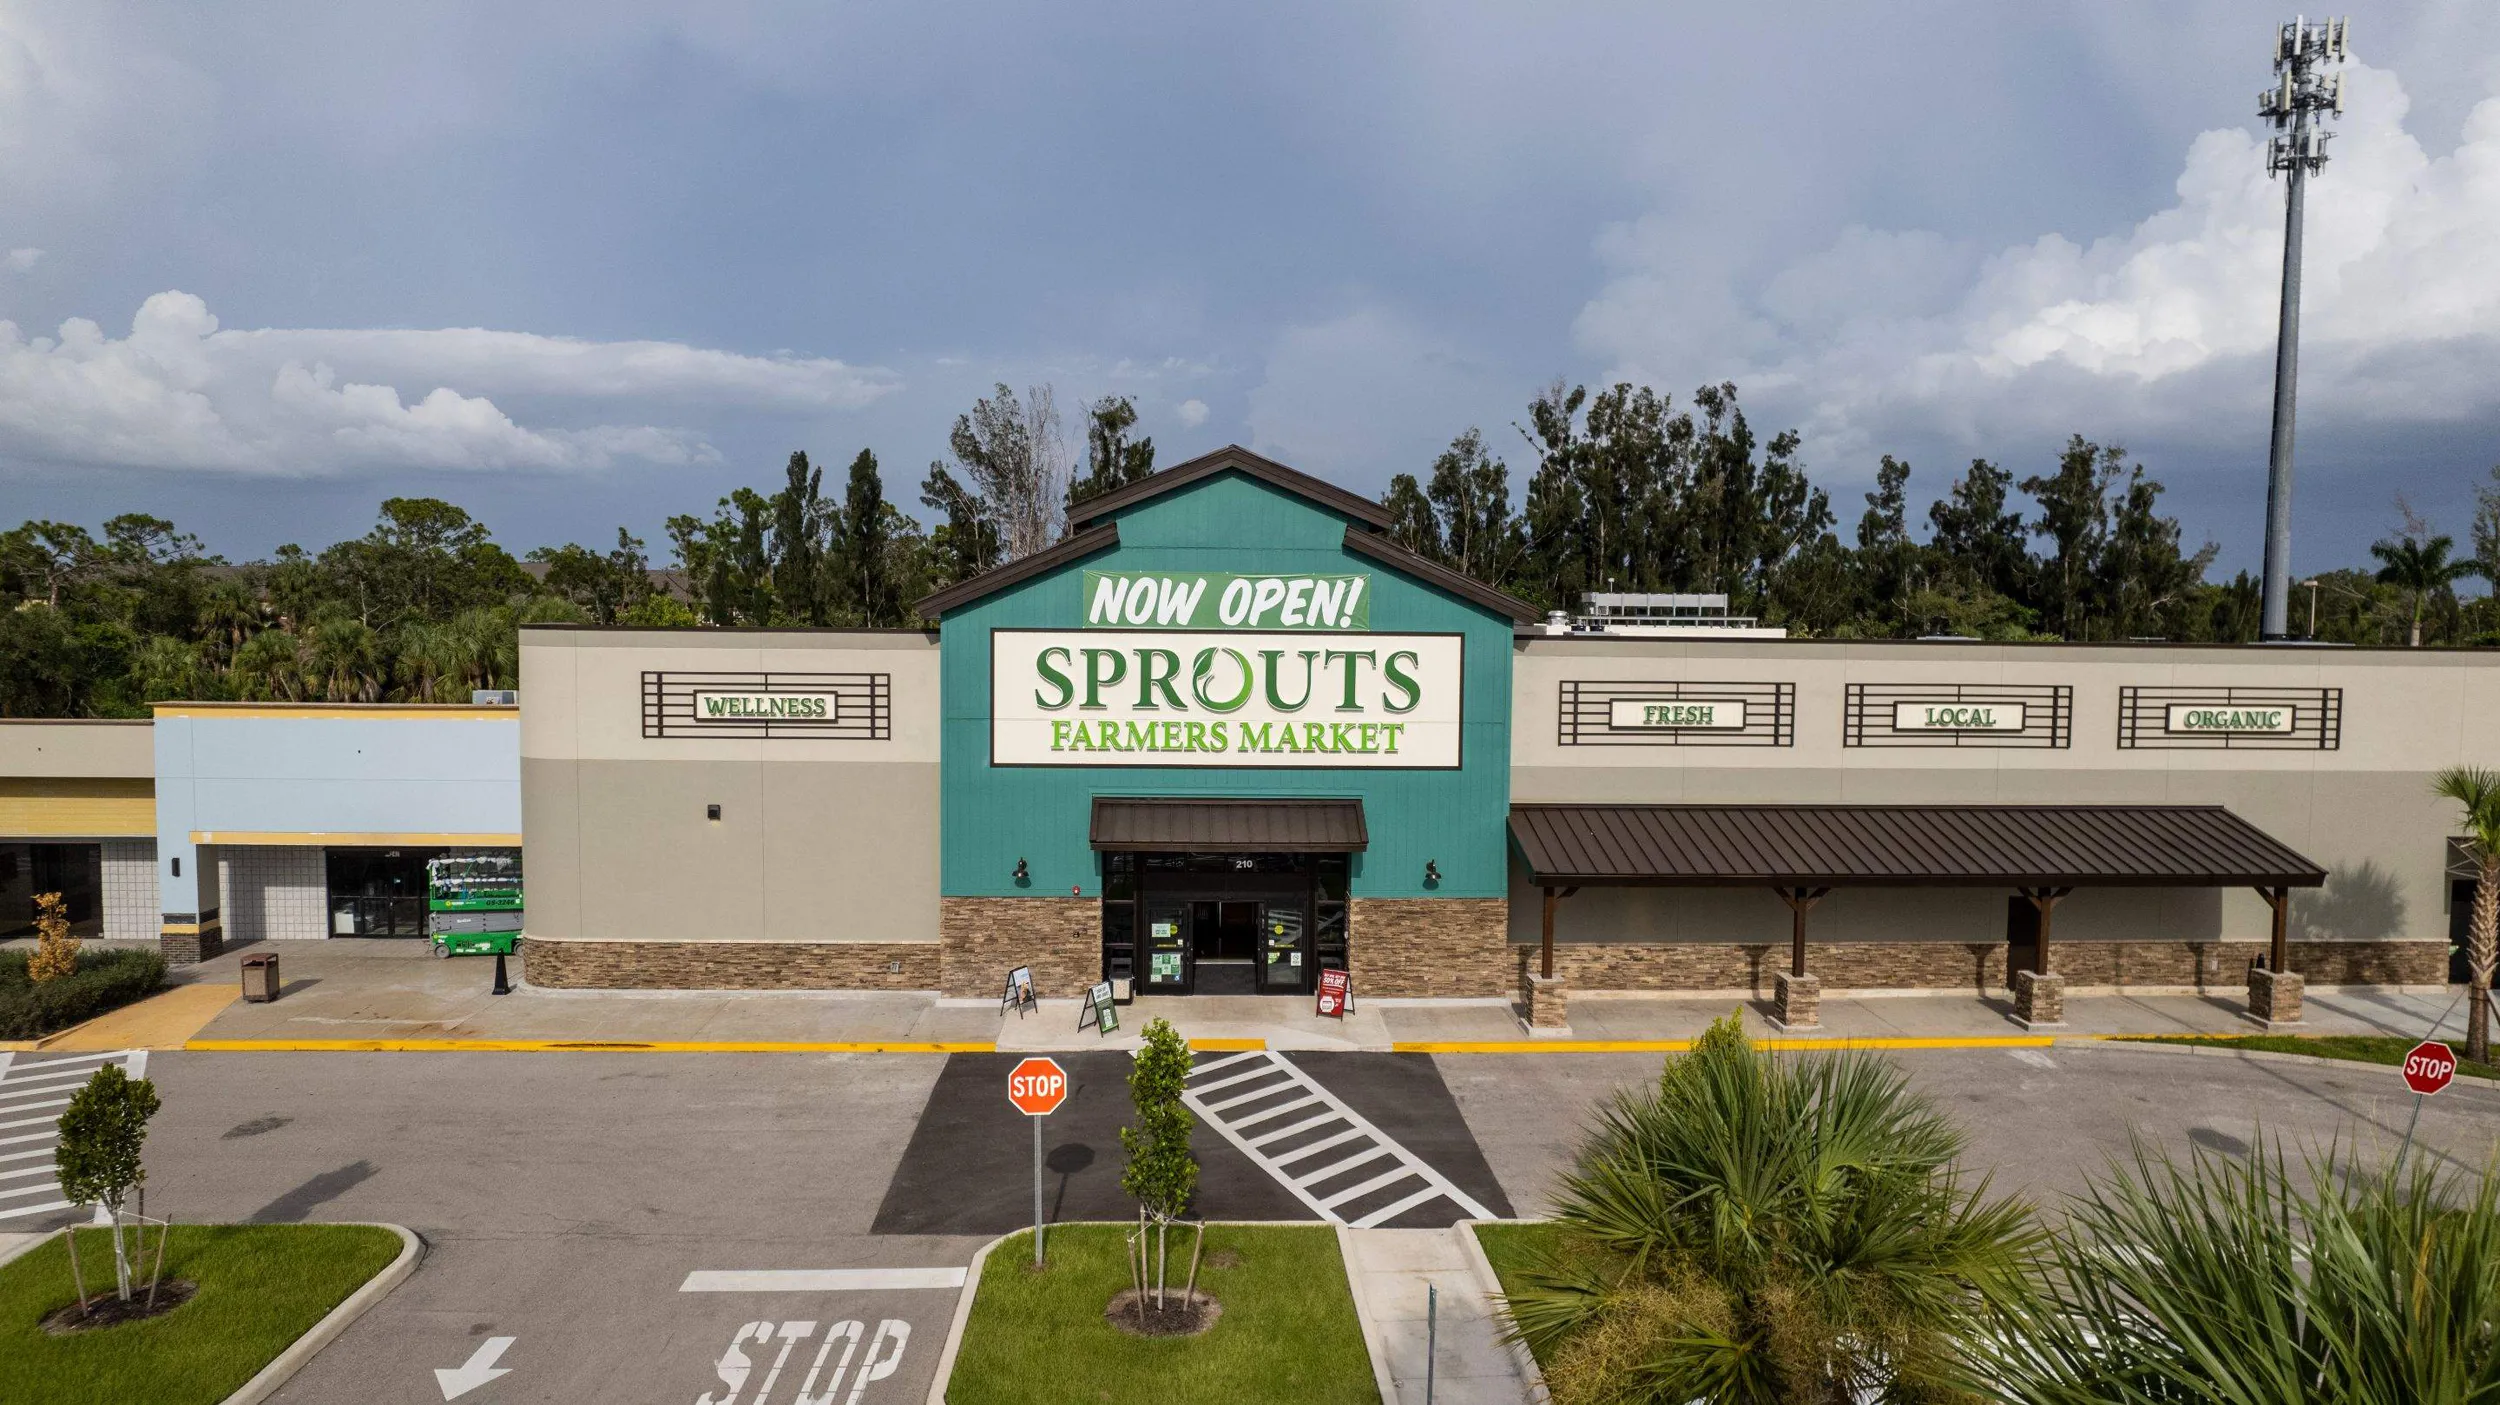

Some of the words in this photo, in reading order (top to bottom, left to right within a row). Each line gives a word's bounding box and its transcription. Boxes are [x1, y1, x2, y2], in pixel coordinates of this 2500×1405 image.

[1089, 576, 1207, 626] NOW
[1219, 576, 1365, 629] OPEN!
[1035, 646, 1422, 713] SPROUTS
[704, 696, 827, 717] WELLNESS
[1643, 705, 1714, 725] FRESH
[1925, 707, 1997, 728] LOCAL
[2184, 710, 2282, 730] ORGANIC
[1050, 719, 1229, 752] FARMERS
[1237, 721, 1405, 754] MARKET
[1236, 860, 1253, 869] 210
[2406, 1055, 2452, 1080] STOP
[1013, 1075, 1063, 1098] STOP
[694, 1318, 912, 1405] STOP
